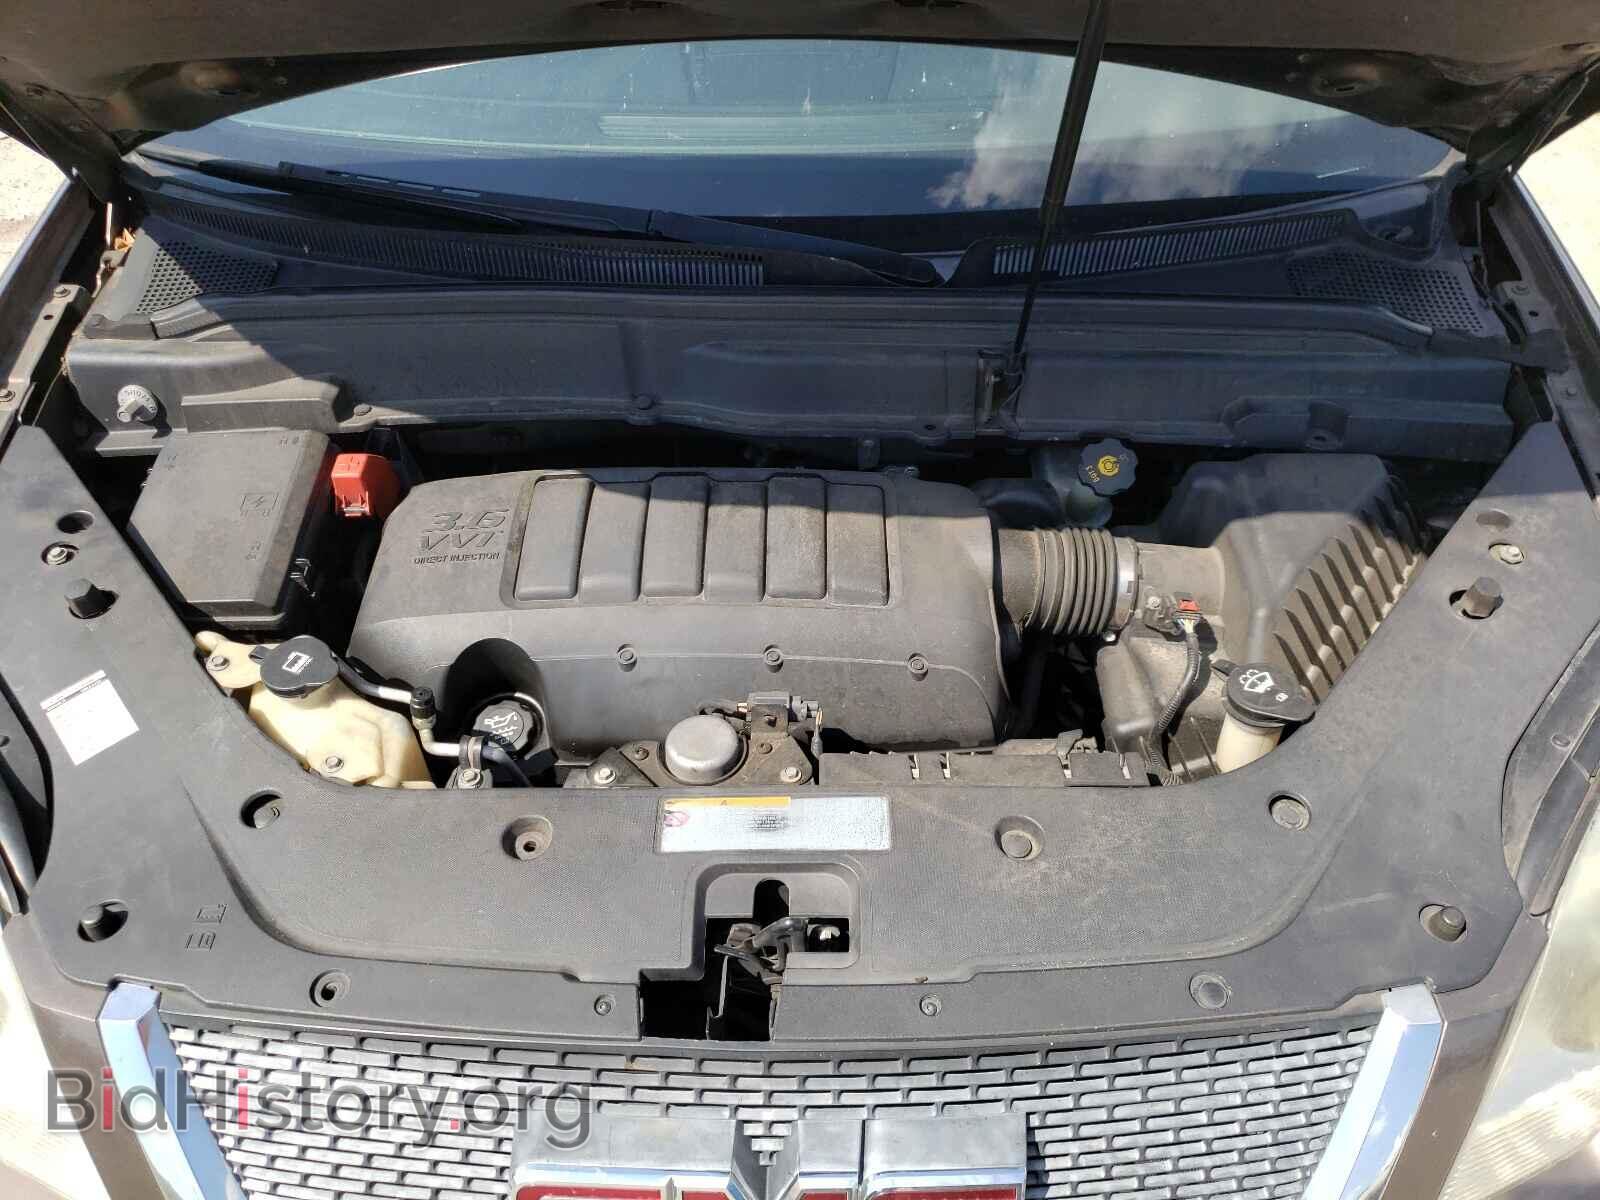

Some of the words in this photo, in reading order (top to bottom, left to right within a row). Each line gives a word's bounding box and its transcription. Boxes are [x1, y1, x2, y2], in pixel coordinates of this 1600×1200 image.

[423, 507, 509, 534] 3.6
[414, 554, 448, 565] DIRECT
[450, 552, 501, 562] INJECTION
